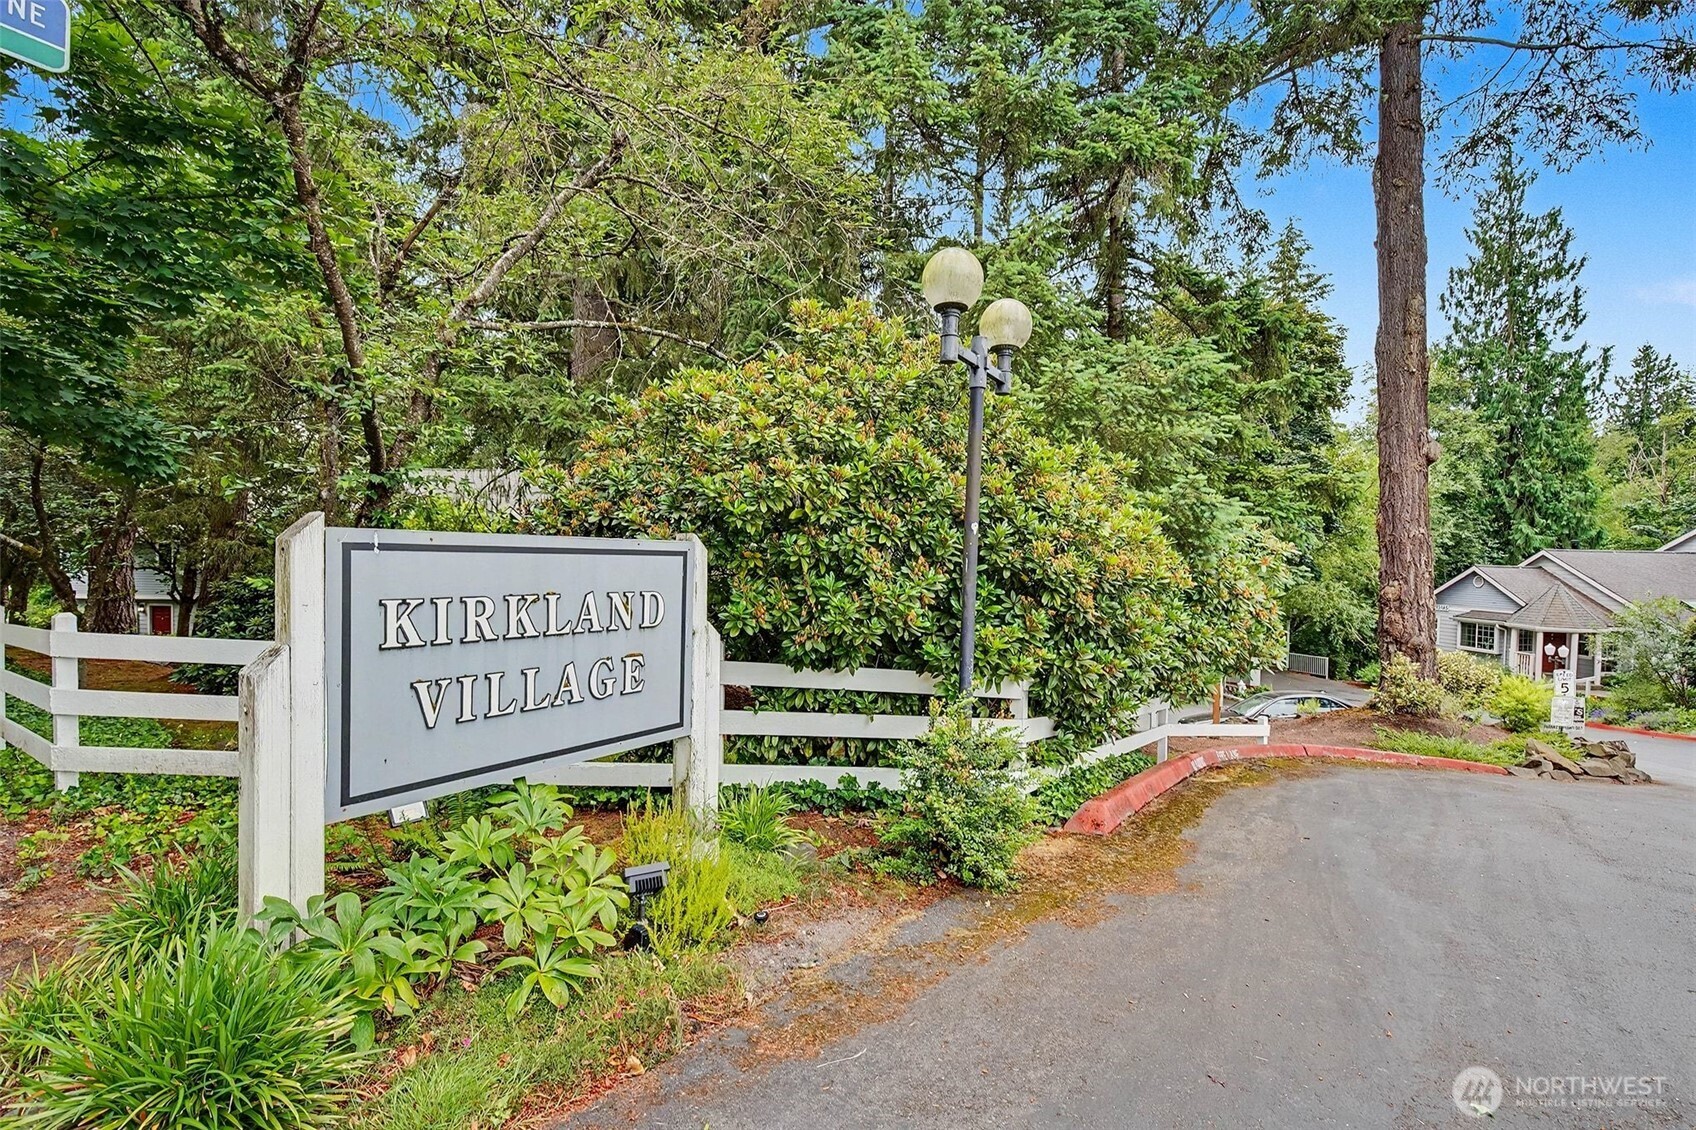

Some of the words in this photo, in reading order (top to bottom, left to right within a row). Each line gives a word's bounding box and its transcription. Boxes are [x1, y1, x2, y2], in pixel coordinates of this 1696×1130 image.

[8, 0, 46, 28] NE
[379, 590, 666, 650] KIRKLAND
[410, 653, 645, 729] VILLAGE
[1561, 683, 1569, 693] 5
